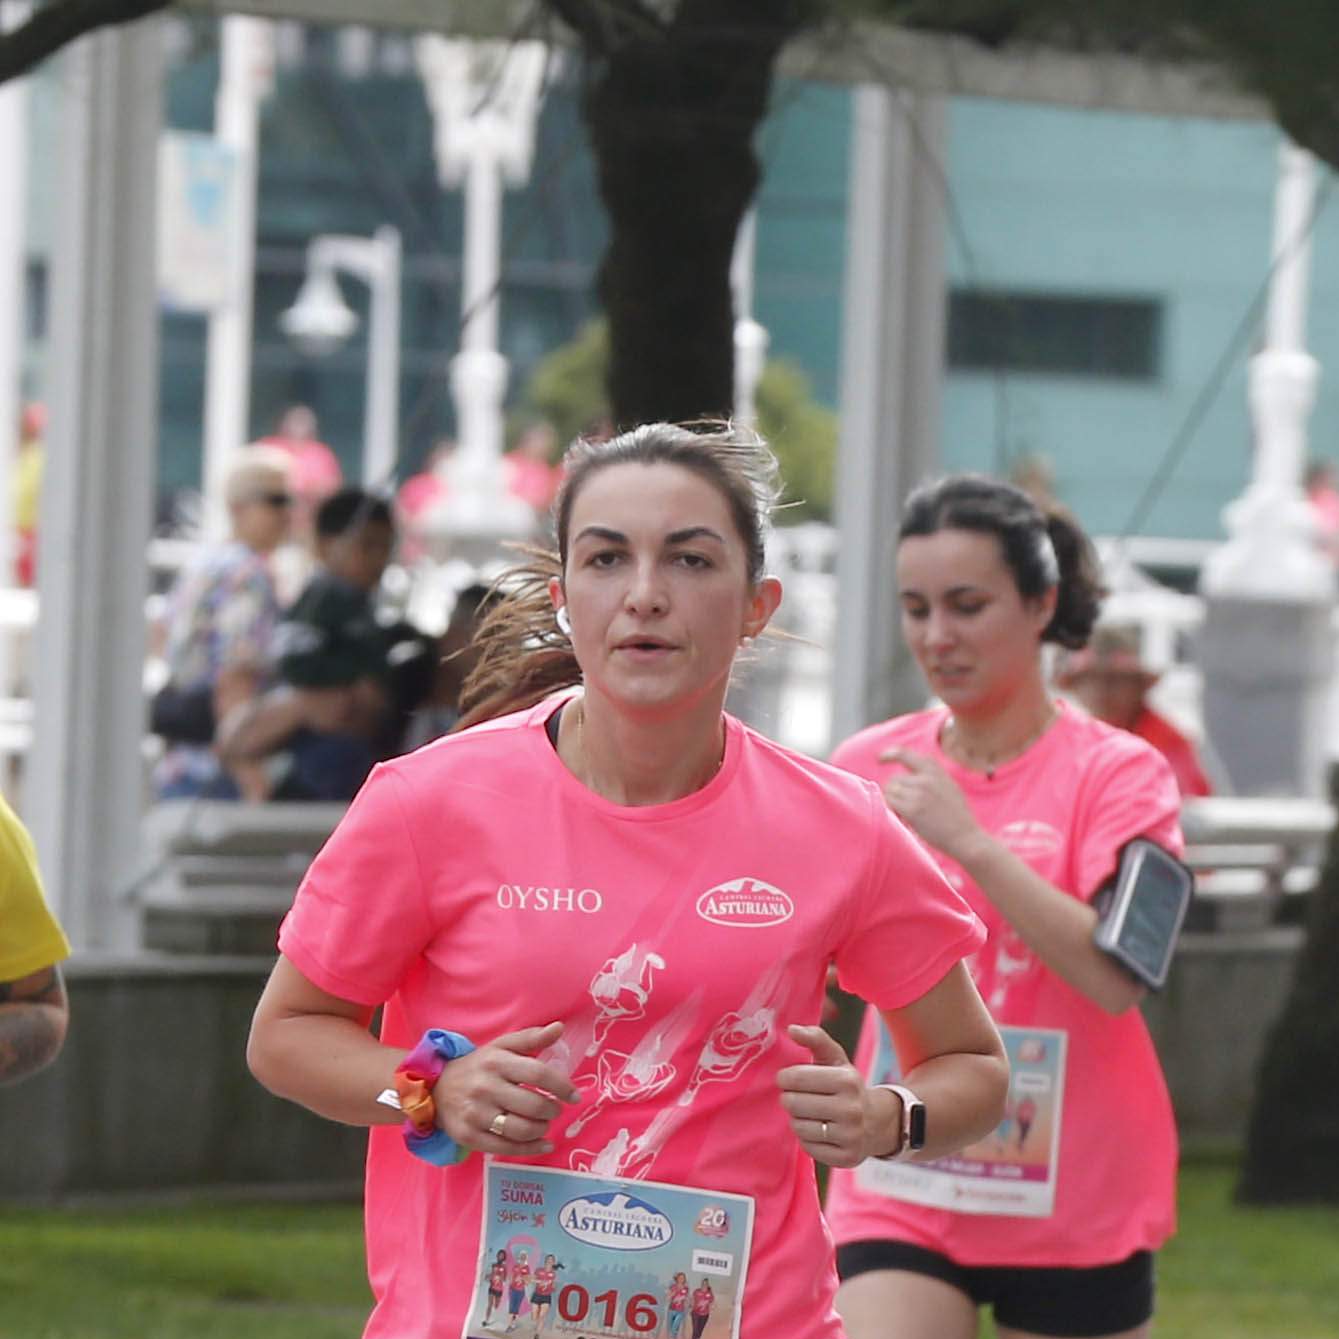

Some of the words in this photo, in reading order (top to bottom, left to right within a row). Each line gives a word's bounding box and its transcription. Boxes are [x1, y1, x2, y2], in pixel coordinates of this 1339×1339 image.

[497, 884, 602, 913] OYSHO
[705, 896, 787, 916] ASTURIANA
[501, 1190, 544, 1206] SUMA
[565, 1208, 664, 1241] ASTURIANA
[701, 1208, 726, 1226] 20
[557, 1283, 658, 1332] 016
